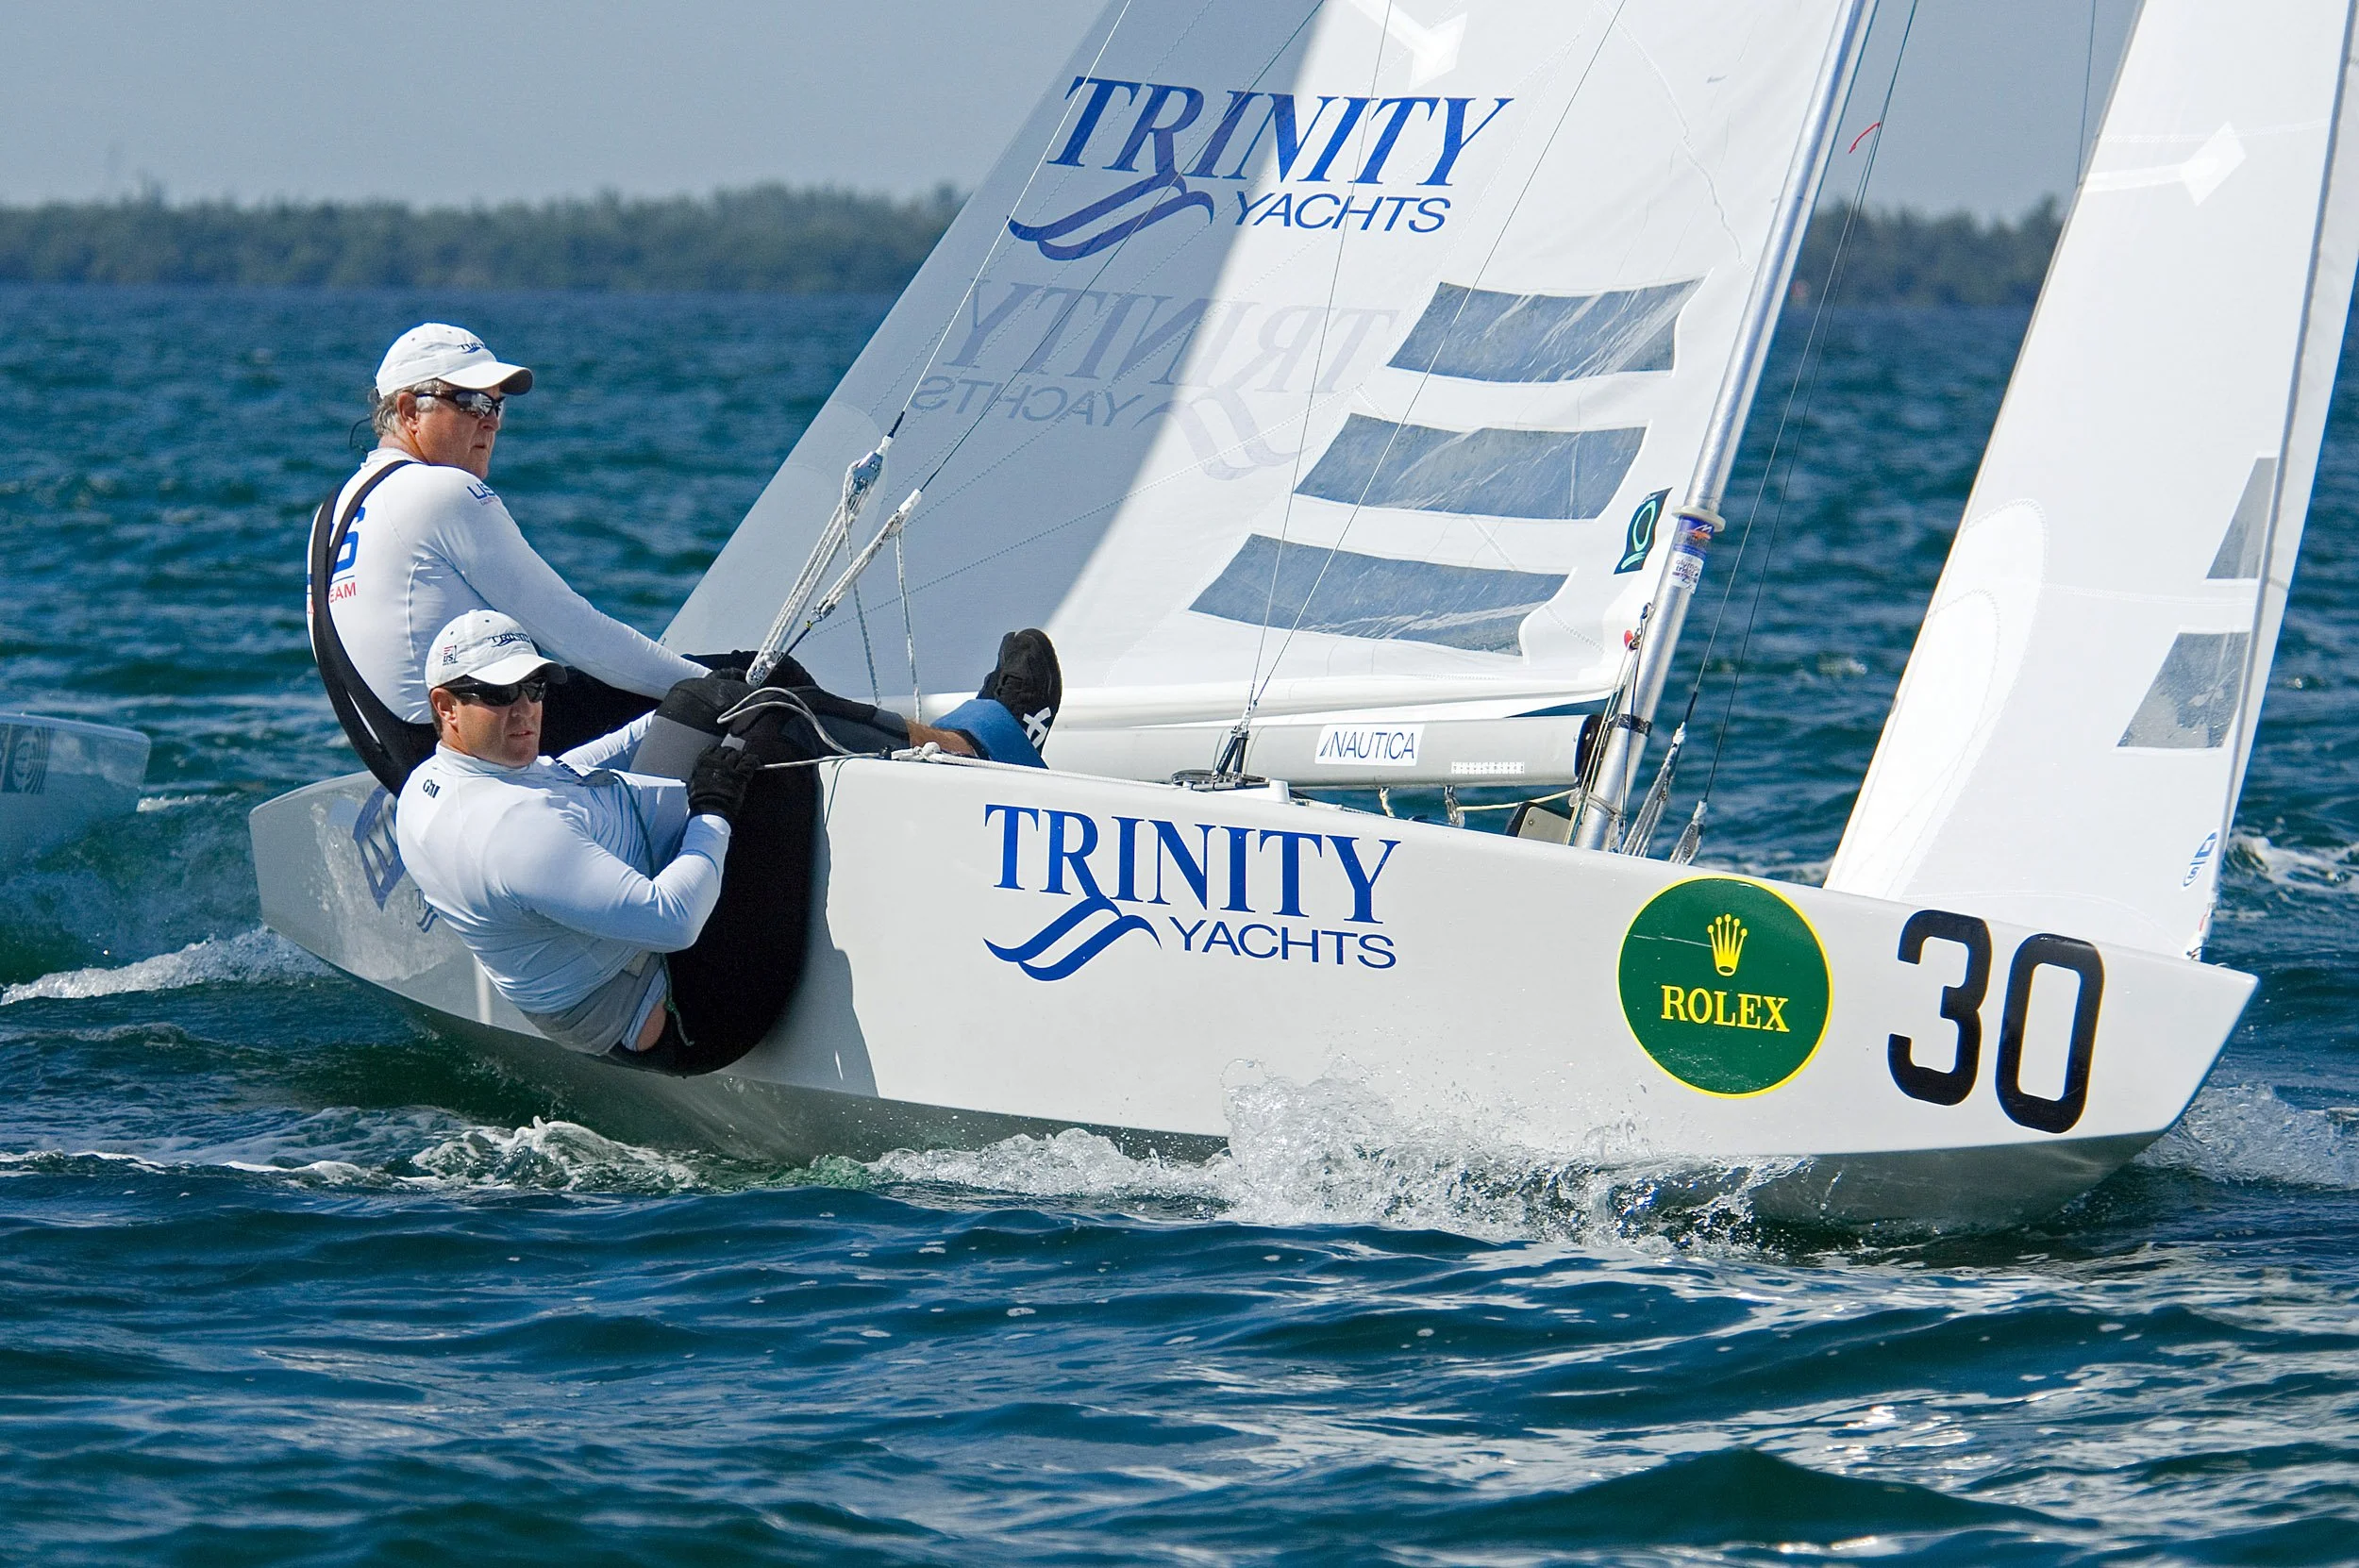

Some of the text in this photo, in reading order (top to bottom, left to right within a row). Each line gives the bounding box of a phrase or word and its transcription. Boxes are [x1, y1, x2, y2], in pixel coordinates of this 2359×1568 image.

[1046, 75, 1514, 187] TRINITY
[1231, 192, 1452, 234] YACHTS
[329, 582, 357, 604] EAM
[1330, 731, 1414, 759] NAUTICA
[984, 804, 1401, 925] TRINITY
[1169, 916, 1397, 970] YACHTS
[1661, 984, 1790, 1033] ROLEX
[1887, 909, 2105, 1134] 30
